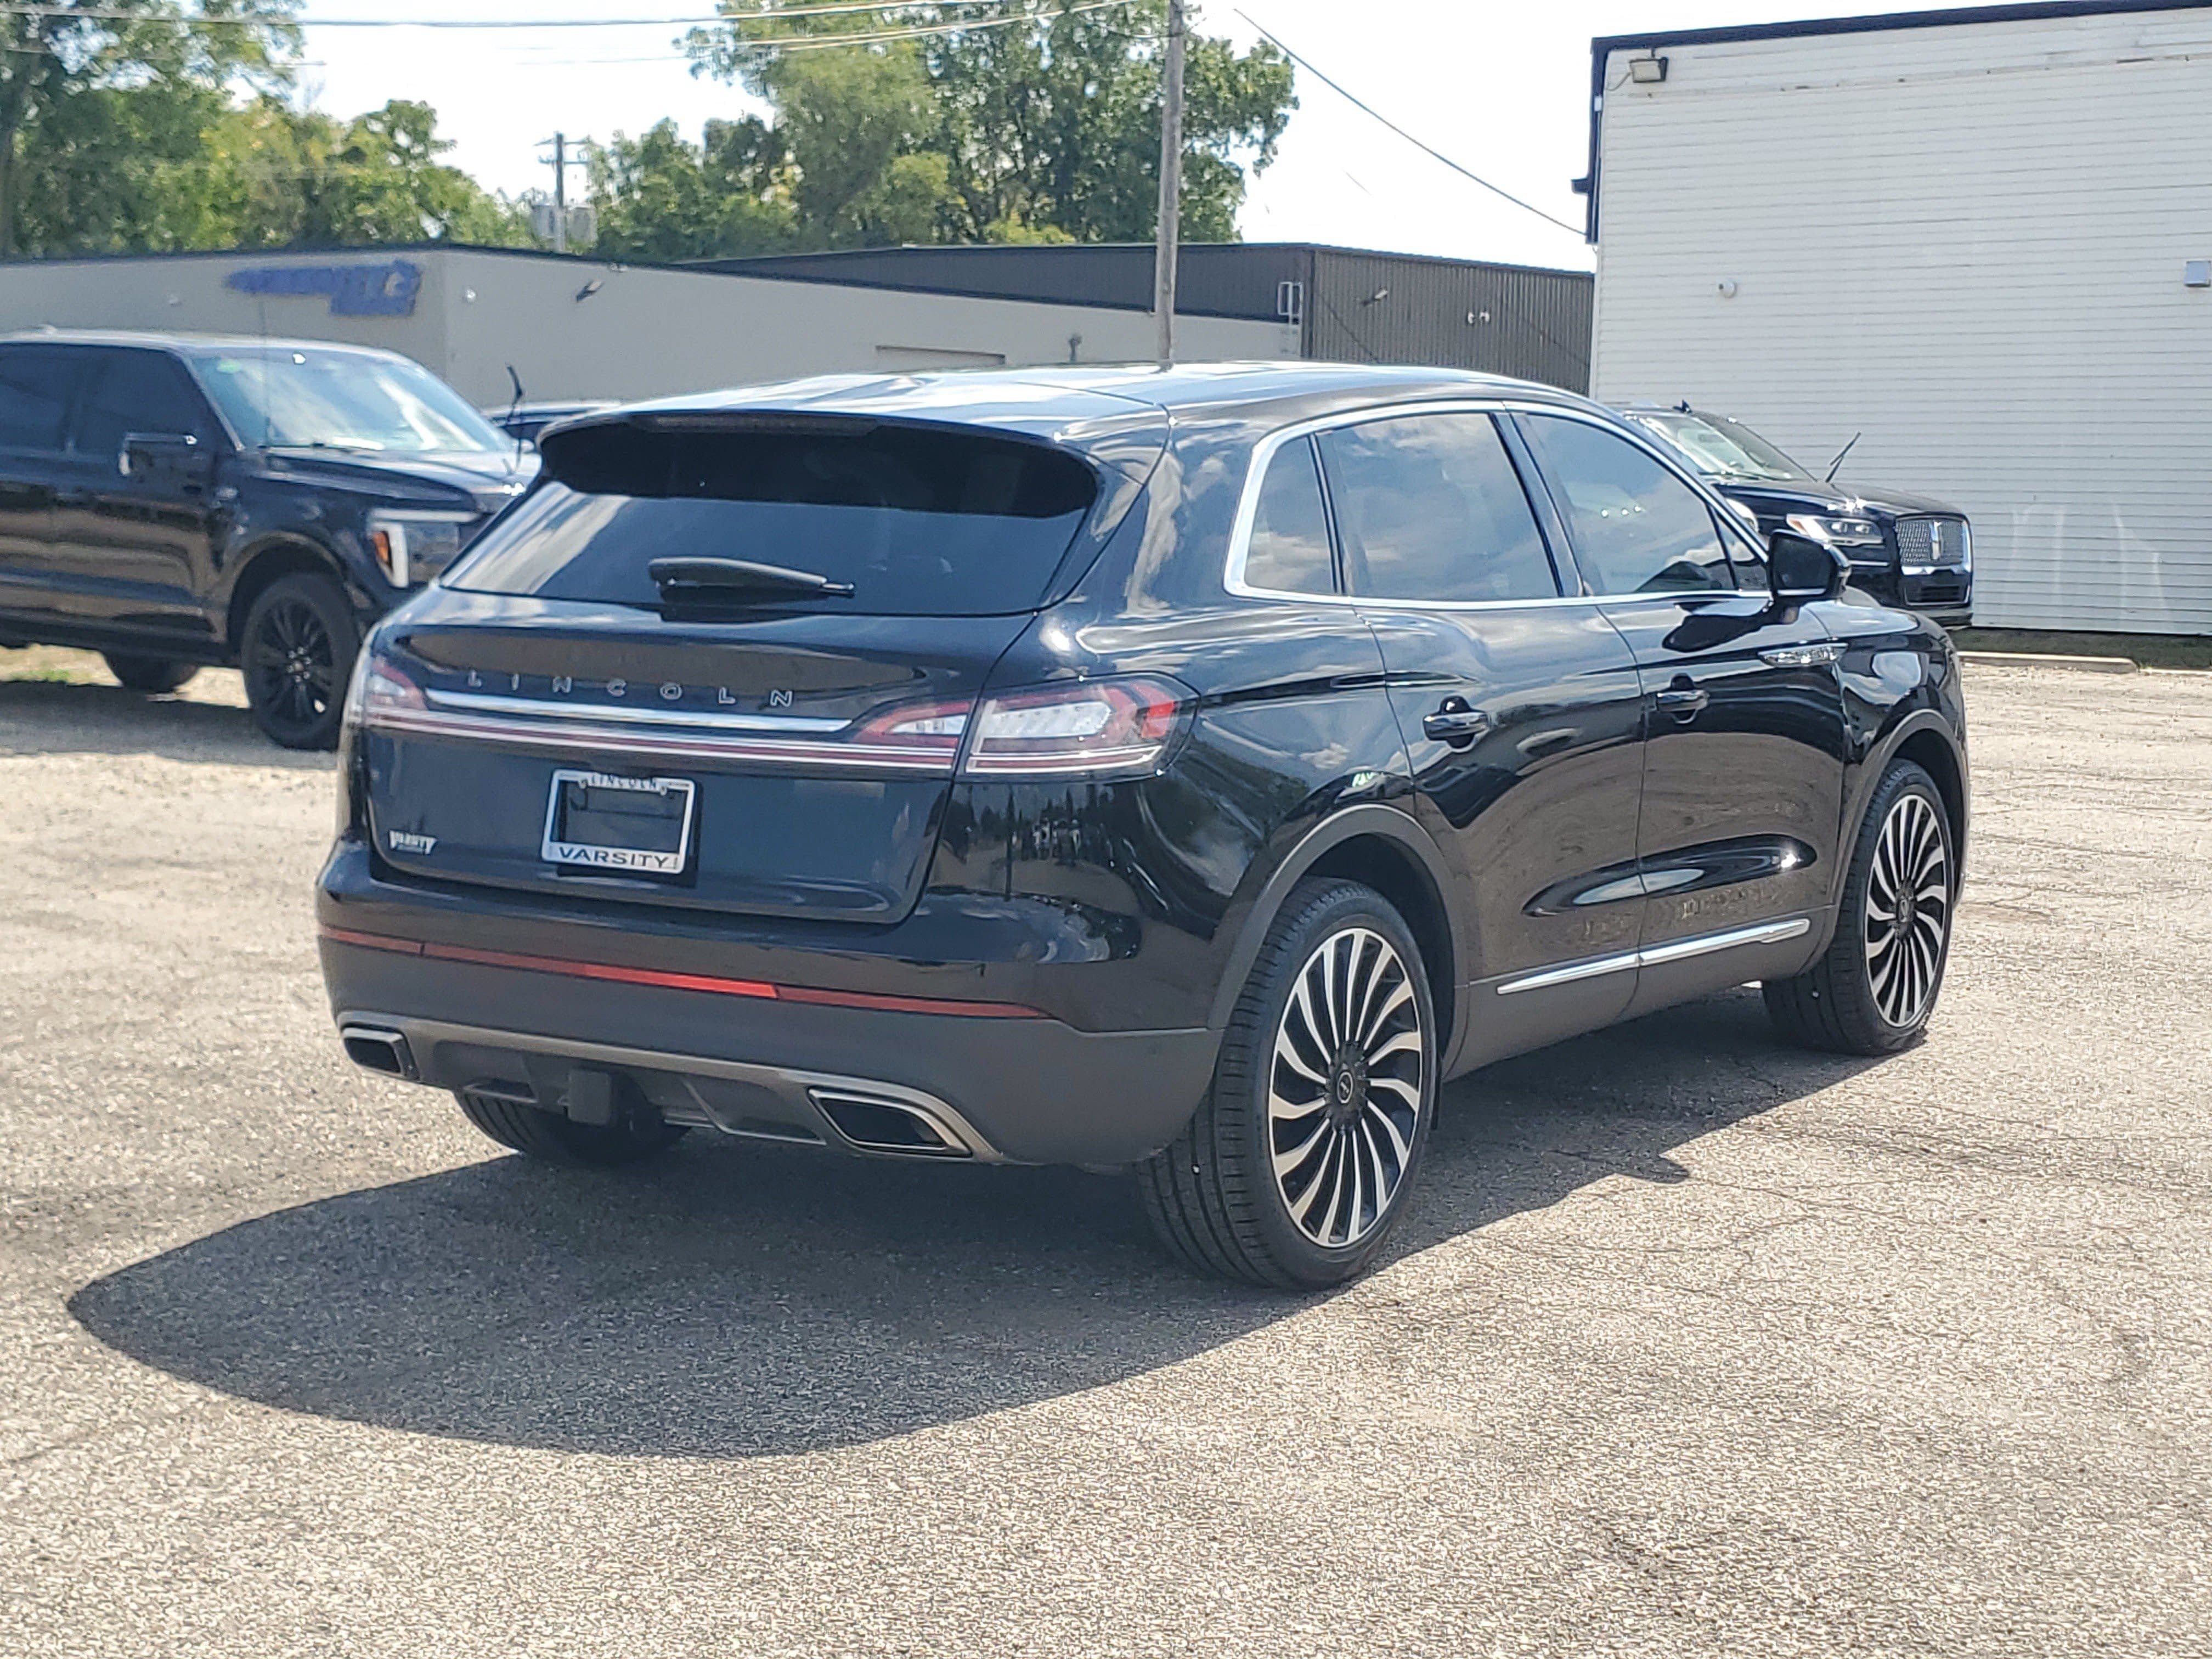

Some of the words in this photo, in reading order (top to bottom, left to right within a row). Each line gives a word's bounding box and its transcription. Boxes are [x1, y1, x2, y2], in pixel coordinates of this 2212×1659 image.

[467, 671, 793, 707] LINCOLN
[591, 773, 657, 790] LINCOLN
[559, 847, 669, 868] VARSITY
